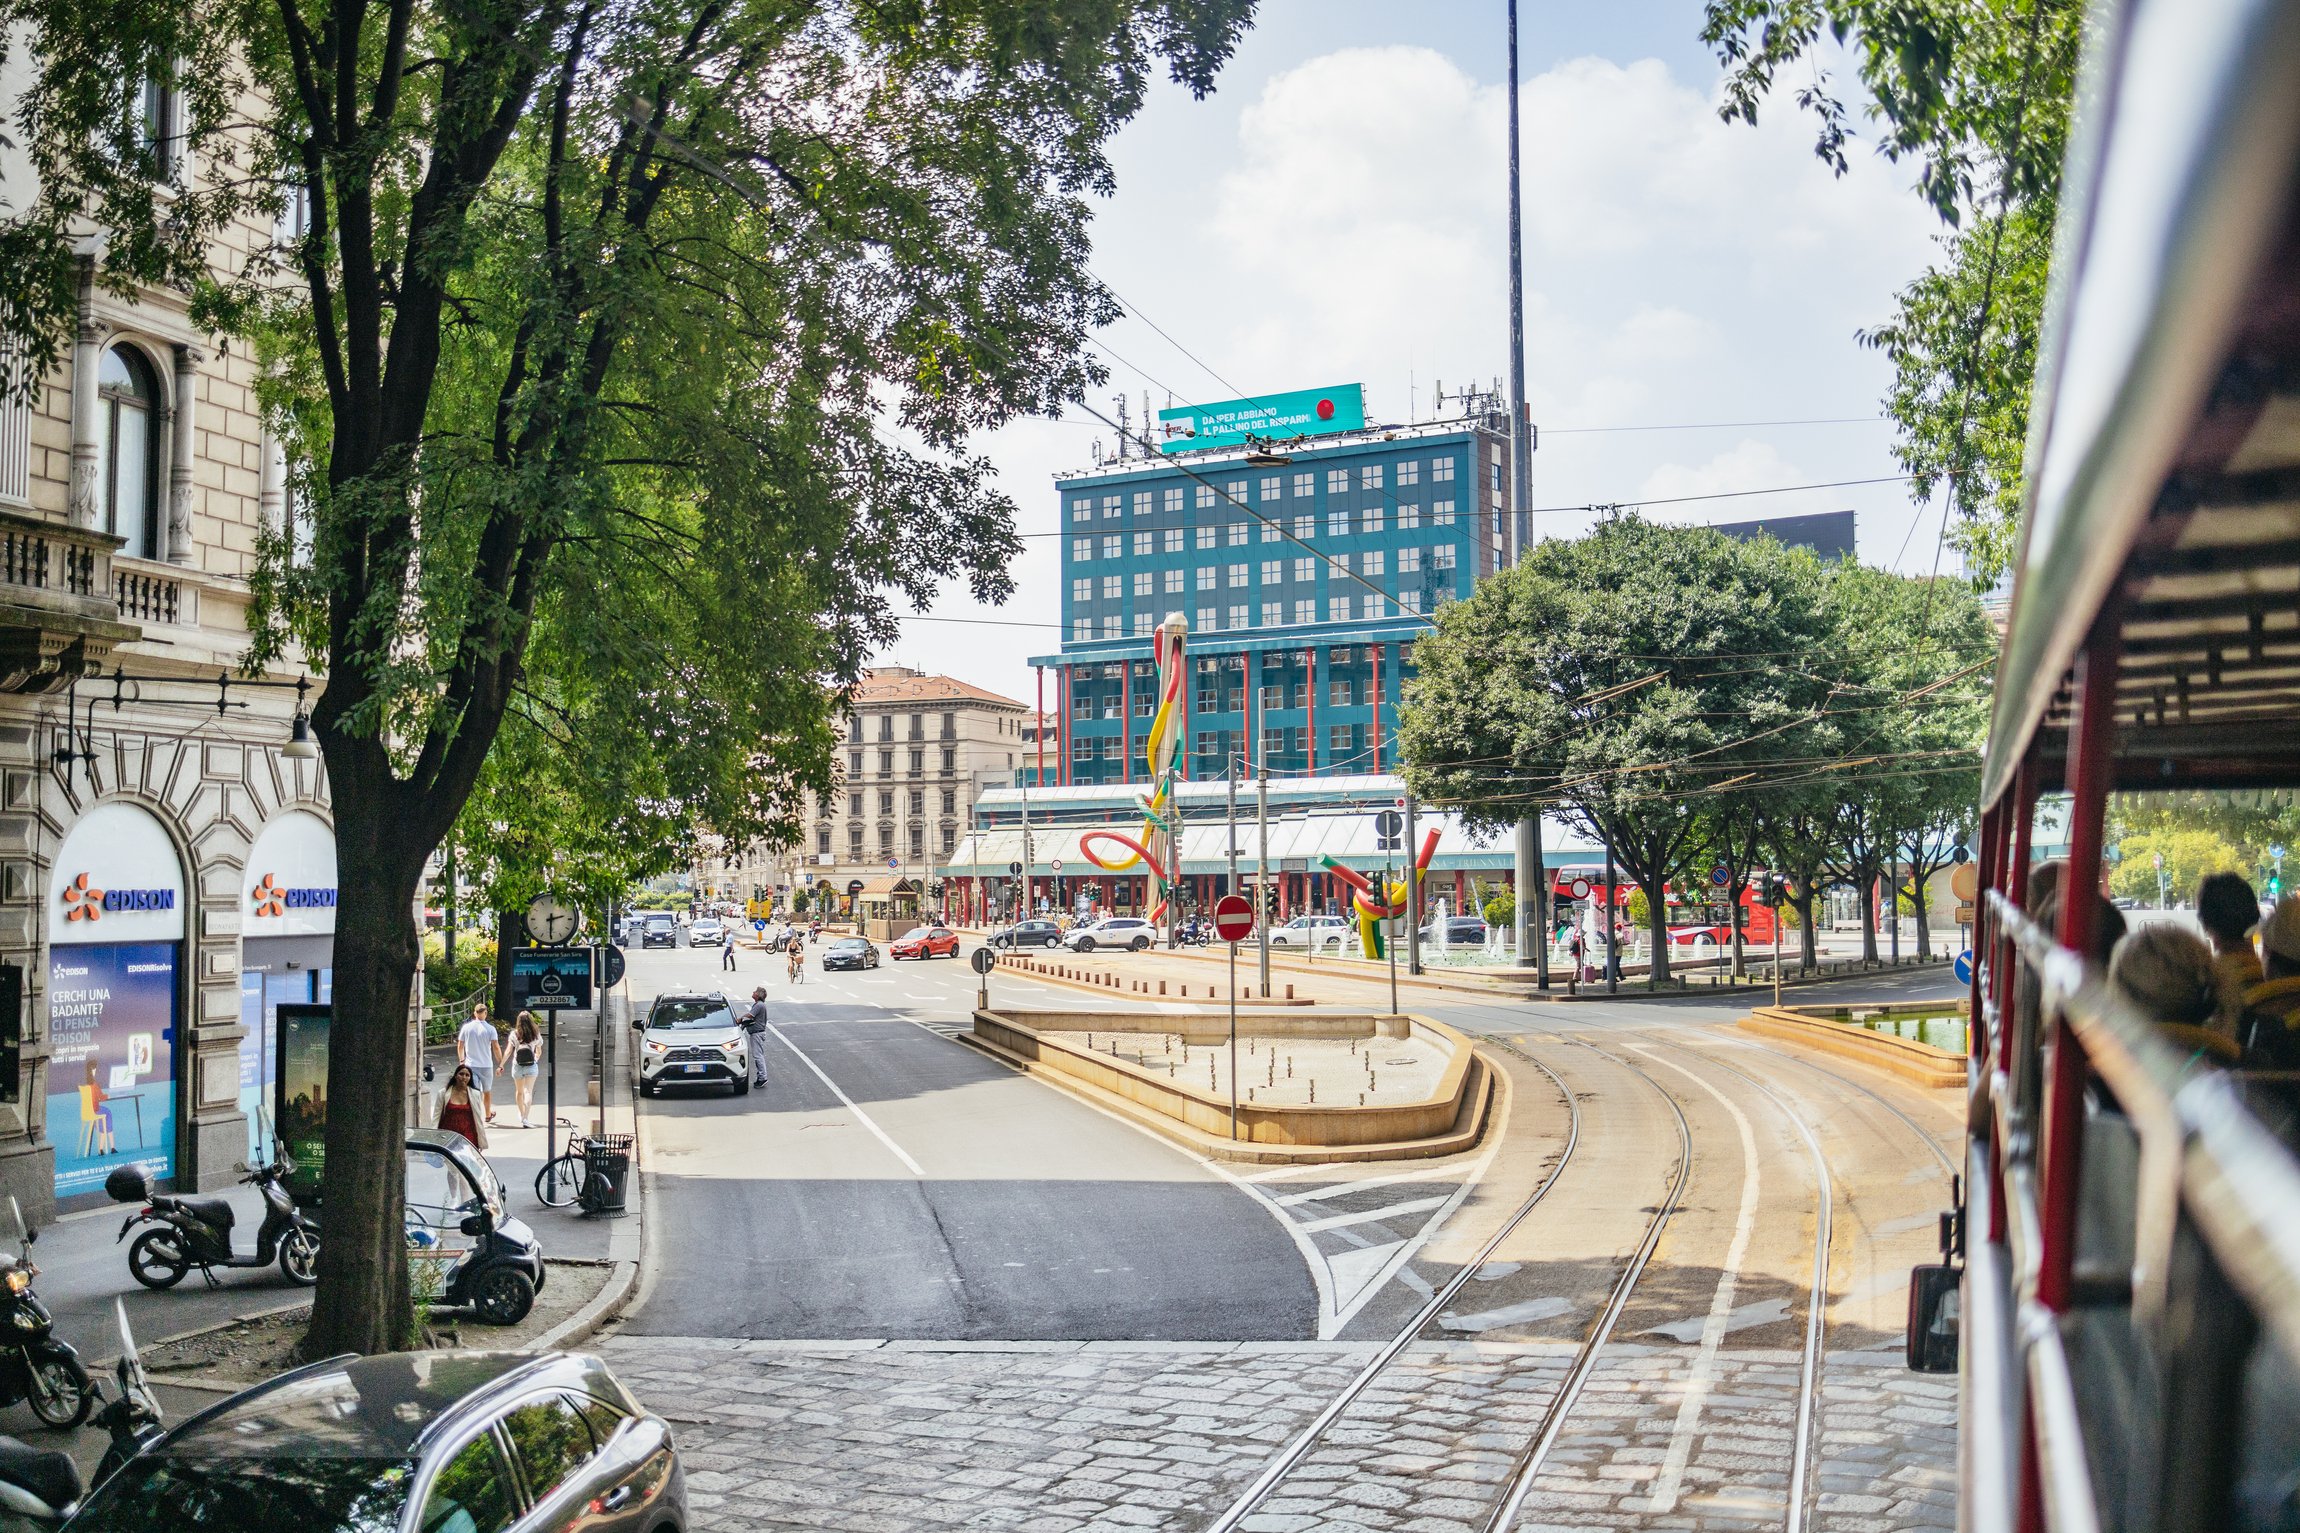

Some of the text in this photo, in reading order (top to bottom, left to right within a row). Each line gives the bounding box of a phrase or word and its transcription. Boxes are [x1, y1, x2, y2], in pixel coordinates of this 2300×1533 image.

[1202, 407, 1277, 426] DA IPER ABBIAMO
[1203, 426, 1212, 436] IL
[1213, 422, 1250, 435] PALLINO
[1252, 420, 1268, 430] DEL
[128, 963, 172, 973] EDISONRisolve
[52, 989, 111, 1003] CERCHI UNA
[51, 1003, 104, 1018] BADANTE?
[52, 1017, 99, 1031] CI PENSA
[51, 1031, 91, 1045] EDISON
